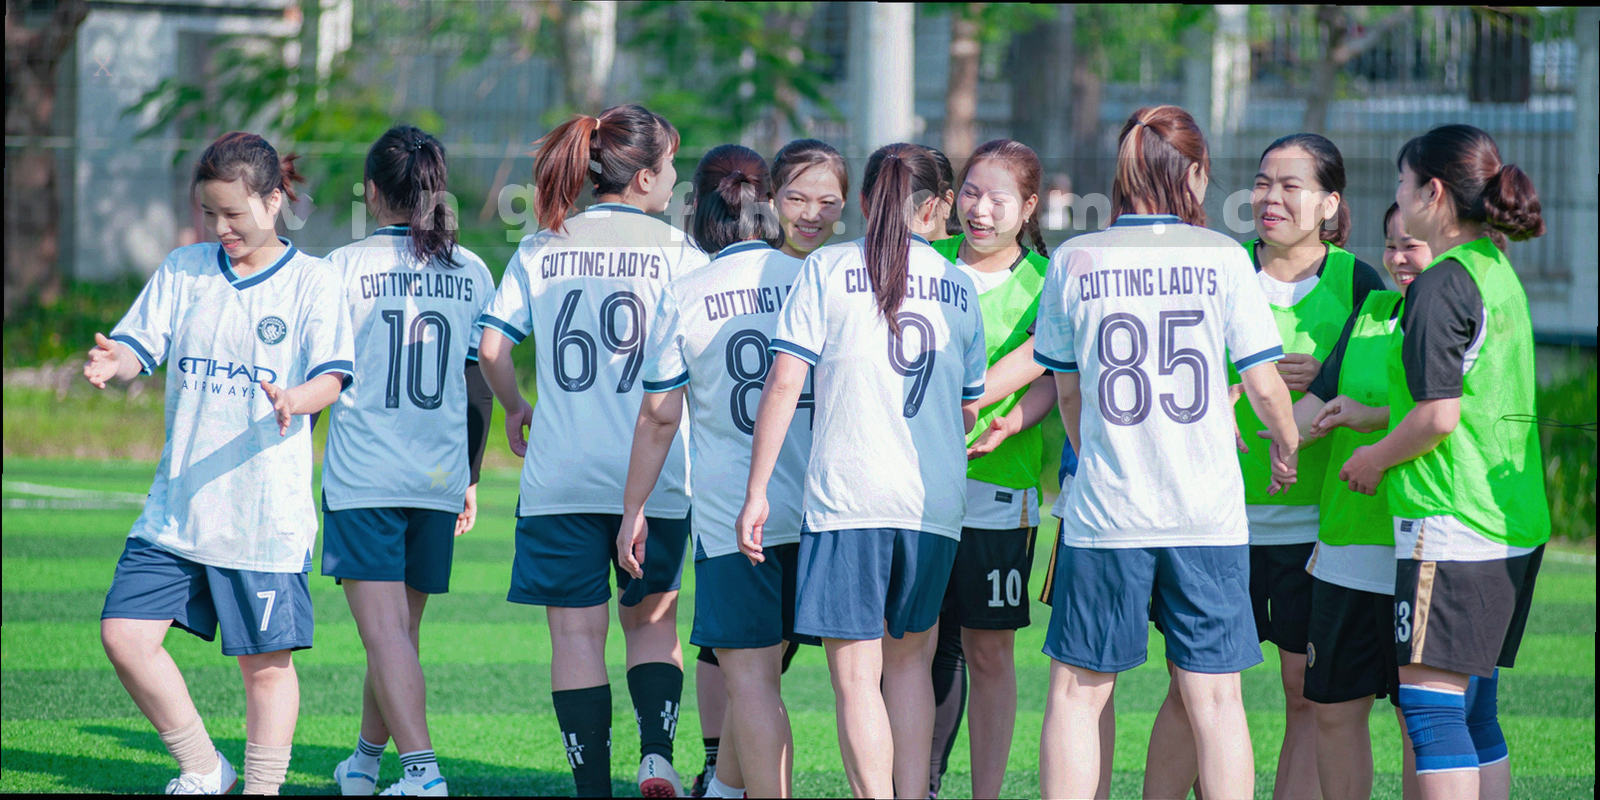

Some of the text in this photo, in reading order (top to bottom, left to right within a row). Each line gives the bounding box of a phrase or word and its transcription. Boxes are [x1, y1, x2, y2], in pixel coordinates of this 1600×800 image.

[541, 251, 661, 280] CUTTING LADYS
[1079, 266, 1217, 302] CUTTING LADYS
[361, 272, 473, 302] CUTTING LADYS
[704, 287, 774, 322] CUTTING
[918, 275, 968, 312] LADYS
[381, 309, 451, 410] 10
[552, 289, 647, 393] 69
[178, 356, 277, 384] ETIHAD
[887, 311, 936, 419] 9
[1099, 309, 1210, 427] 85
[182, 380, 255, 399] AIRWAYS
[987, 568, 1022, 607] 10
[256, 590, 276, 631] 7
[1394, 600, 1411, 643] 3
